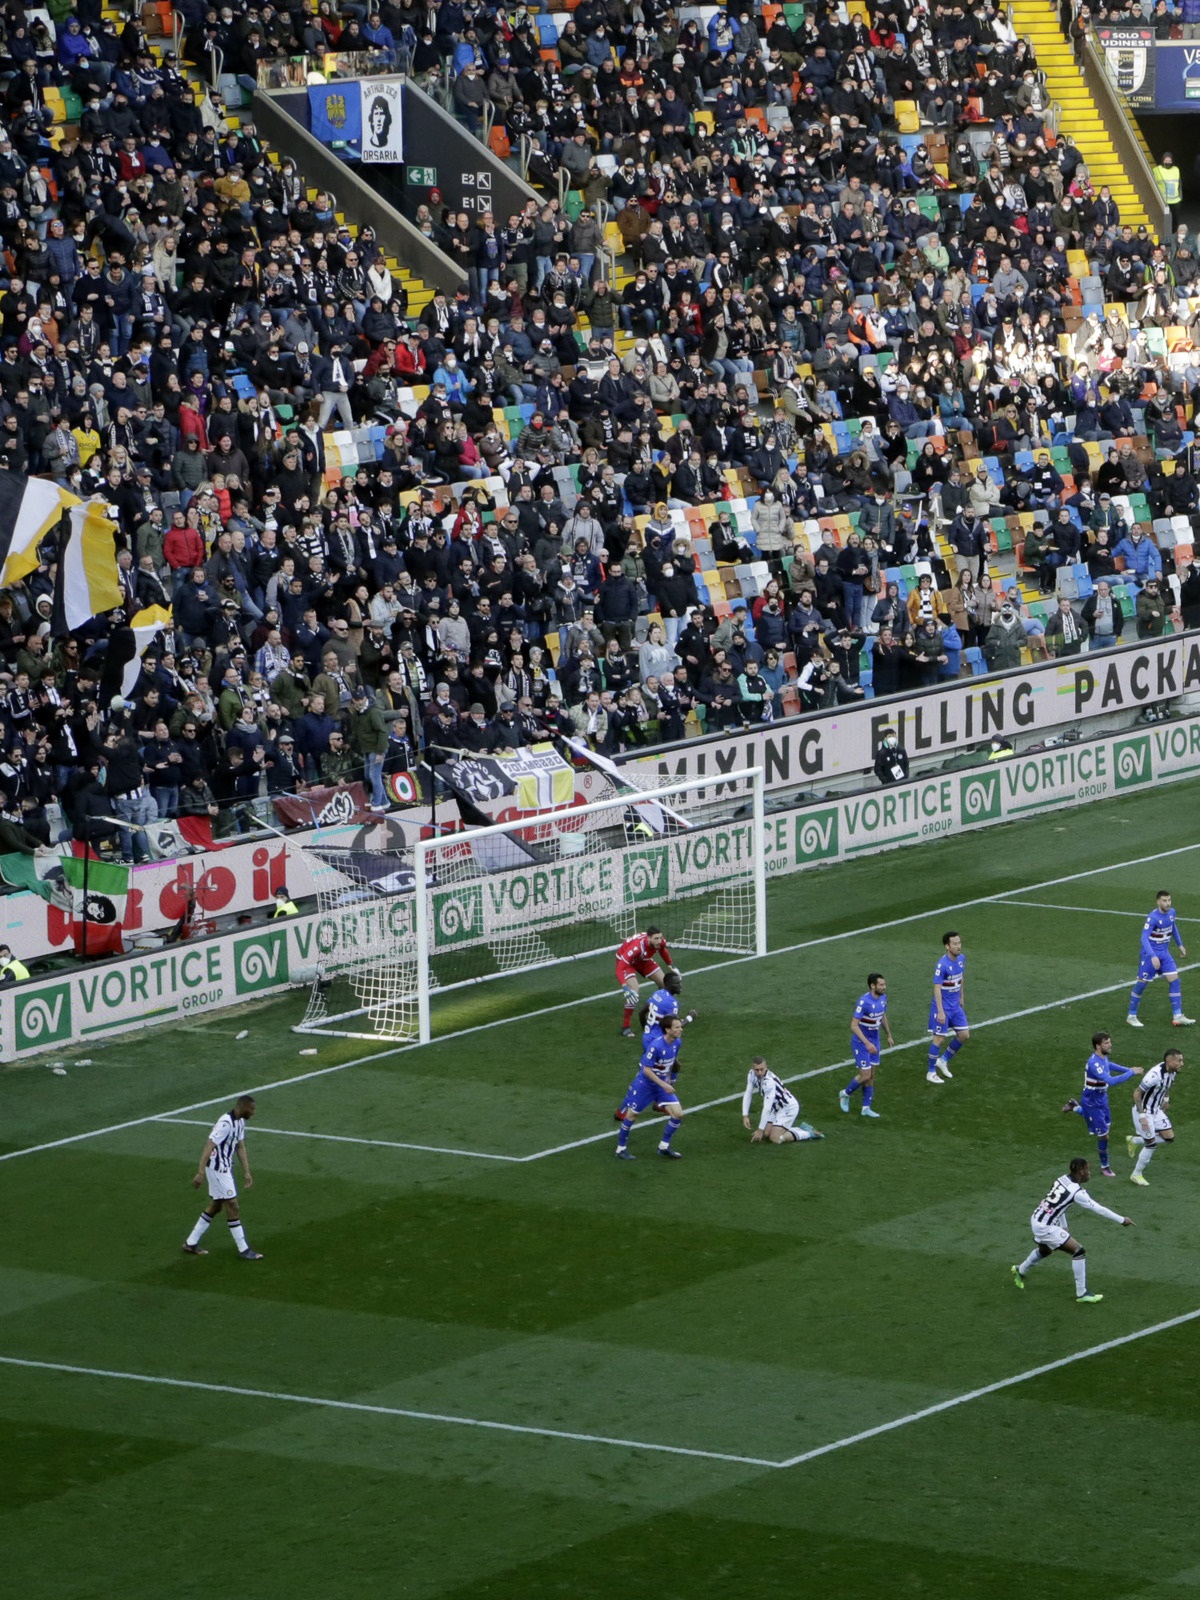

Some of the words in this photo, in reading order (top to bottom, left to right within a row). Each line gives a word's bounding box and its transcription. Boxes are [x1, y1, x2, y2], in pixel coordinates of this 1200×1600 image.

[363, 83, 385, 99] ARTHUR
[385, 84, 398, 99] ZICO
[363, 149, 398, 161] ORSARIA
[461, 173, 475, 185] E2
[462, 197, 475, 208] E1
[658, 728, 824, 807] MIXING
[871, 681, 1035, 761] FILLING
[1006, 746, 1106, 796] VORTICE
[1078, 782, 1108, 798] GROUP
[845, 781, 952, 834] VORTICE
[922, 818, 952, 835] GROUP
[764, 857, 788, 872] ROUP
[159, 861, 236, 920] do
[253, 843, 292, 901] it
[78, 945, 223, 1013] VORTICE
[183, 988, 223, 1009] GROUP
